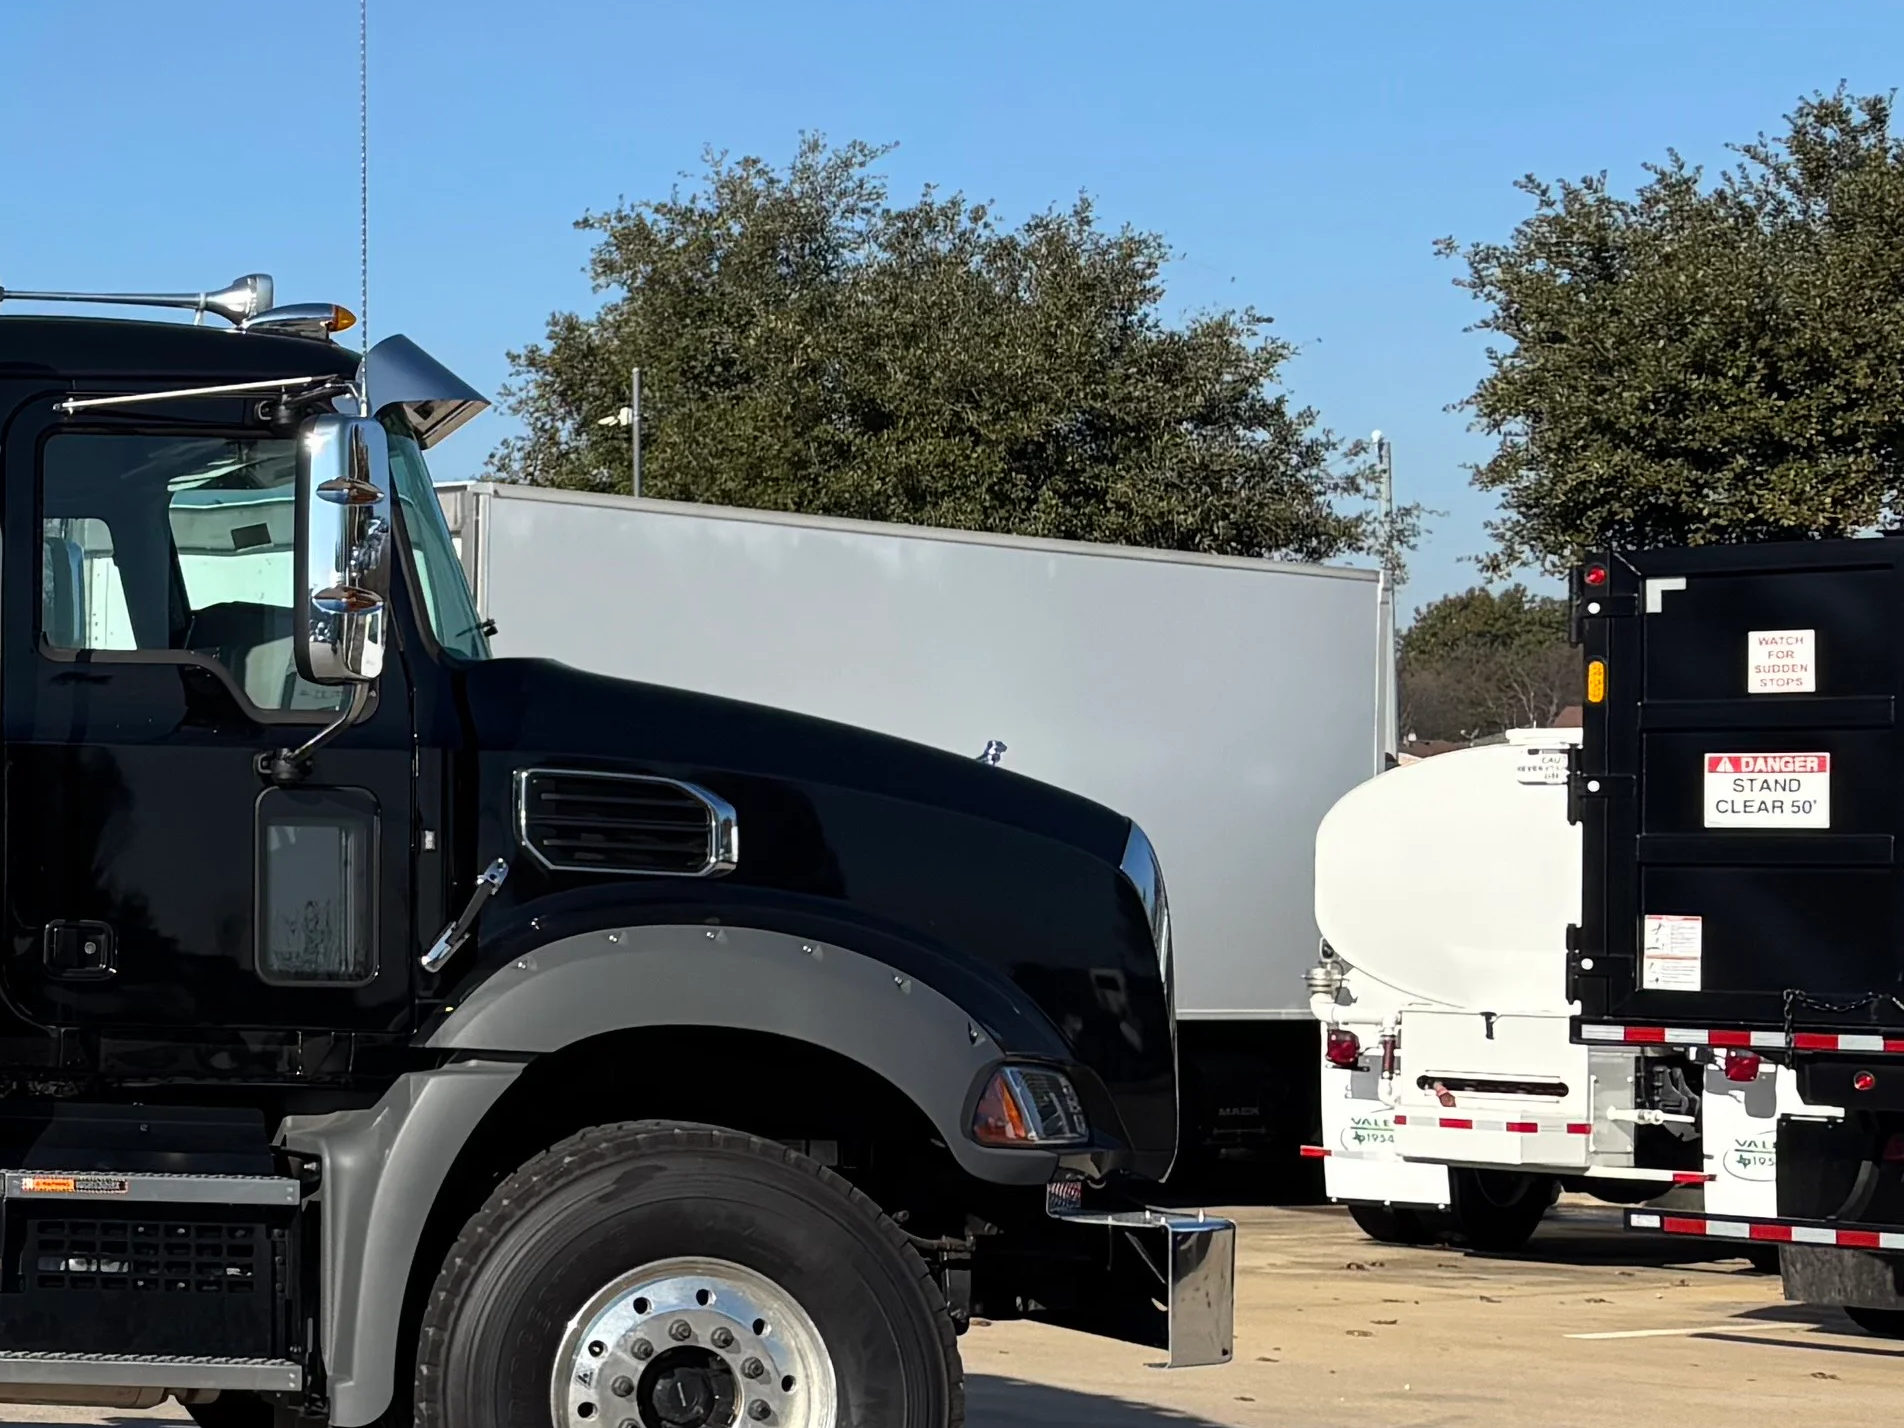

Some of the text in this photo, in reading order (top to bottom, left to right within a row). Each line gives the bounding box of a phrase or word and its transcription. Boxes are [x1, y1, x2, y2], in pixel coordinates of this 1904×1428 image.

[1758, 636, 1804, 646] WATCH
[1768, 650, 1795, 659] FOR
[1754, 663, 1808, 673] SUDDEN
[1760, 677, 1803, 687] STOPS
[1741, 756, 1819, 772] DANGER
[1733, 778, 1801, 792] STAND
[1715, 799, 1817, 814] CLEAR 50'
